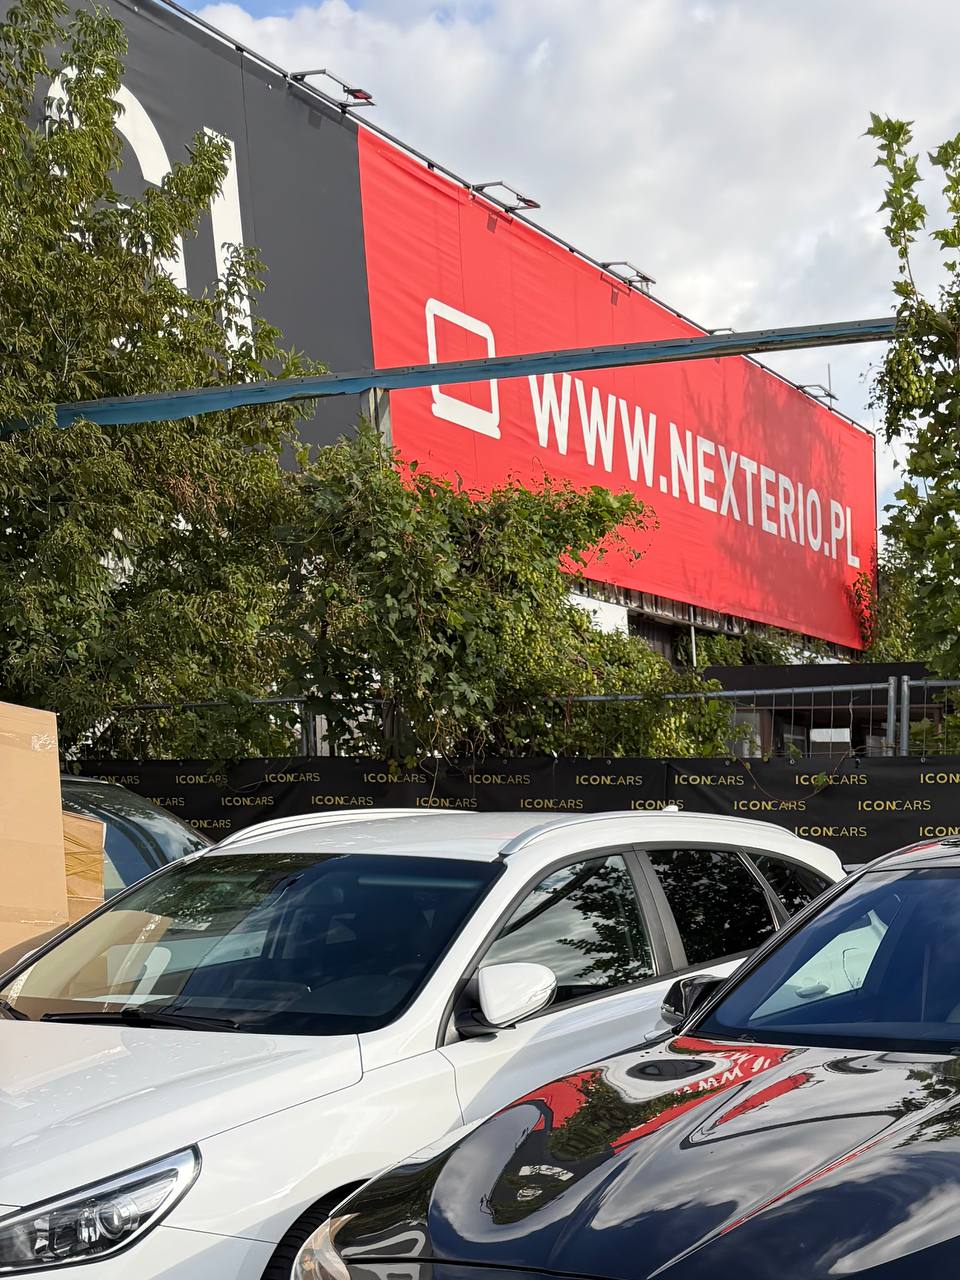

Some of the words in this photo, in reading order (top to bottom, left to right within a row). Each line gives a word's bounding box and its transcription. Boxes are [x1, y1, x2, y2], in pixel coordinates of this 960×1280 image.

[527, 372, 862, 569] WWW.NEXTERIO.PL
[175, 775, 228, 785] ICONCARS
[264, 772, 320, 783] ICONCARS
[363, 772, 427, 784] ICONCARS
[468, 774, 530, 784] ICONCARS
[575, 775, 643, 786] ICONCARS
[674, 774, 744, 786] ICONCARS
[221, 796, 274, 806] ICONCARS
[311, 795, 374, 806] ICONCARS
[416, 796, 478, 808] ICONCARS
[520, 798, 584, 809] ICONCARS
[733, 799, 806, 811] ICONCARS
[858, 799, 932, 811] ICONCARS
[794, 826, 868, 837] ICONCARS
